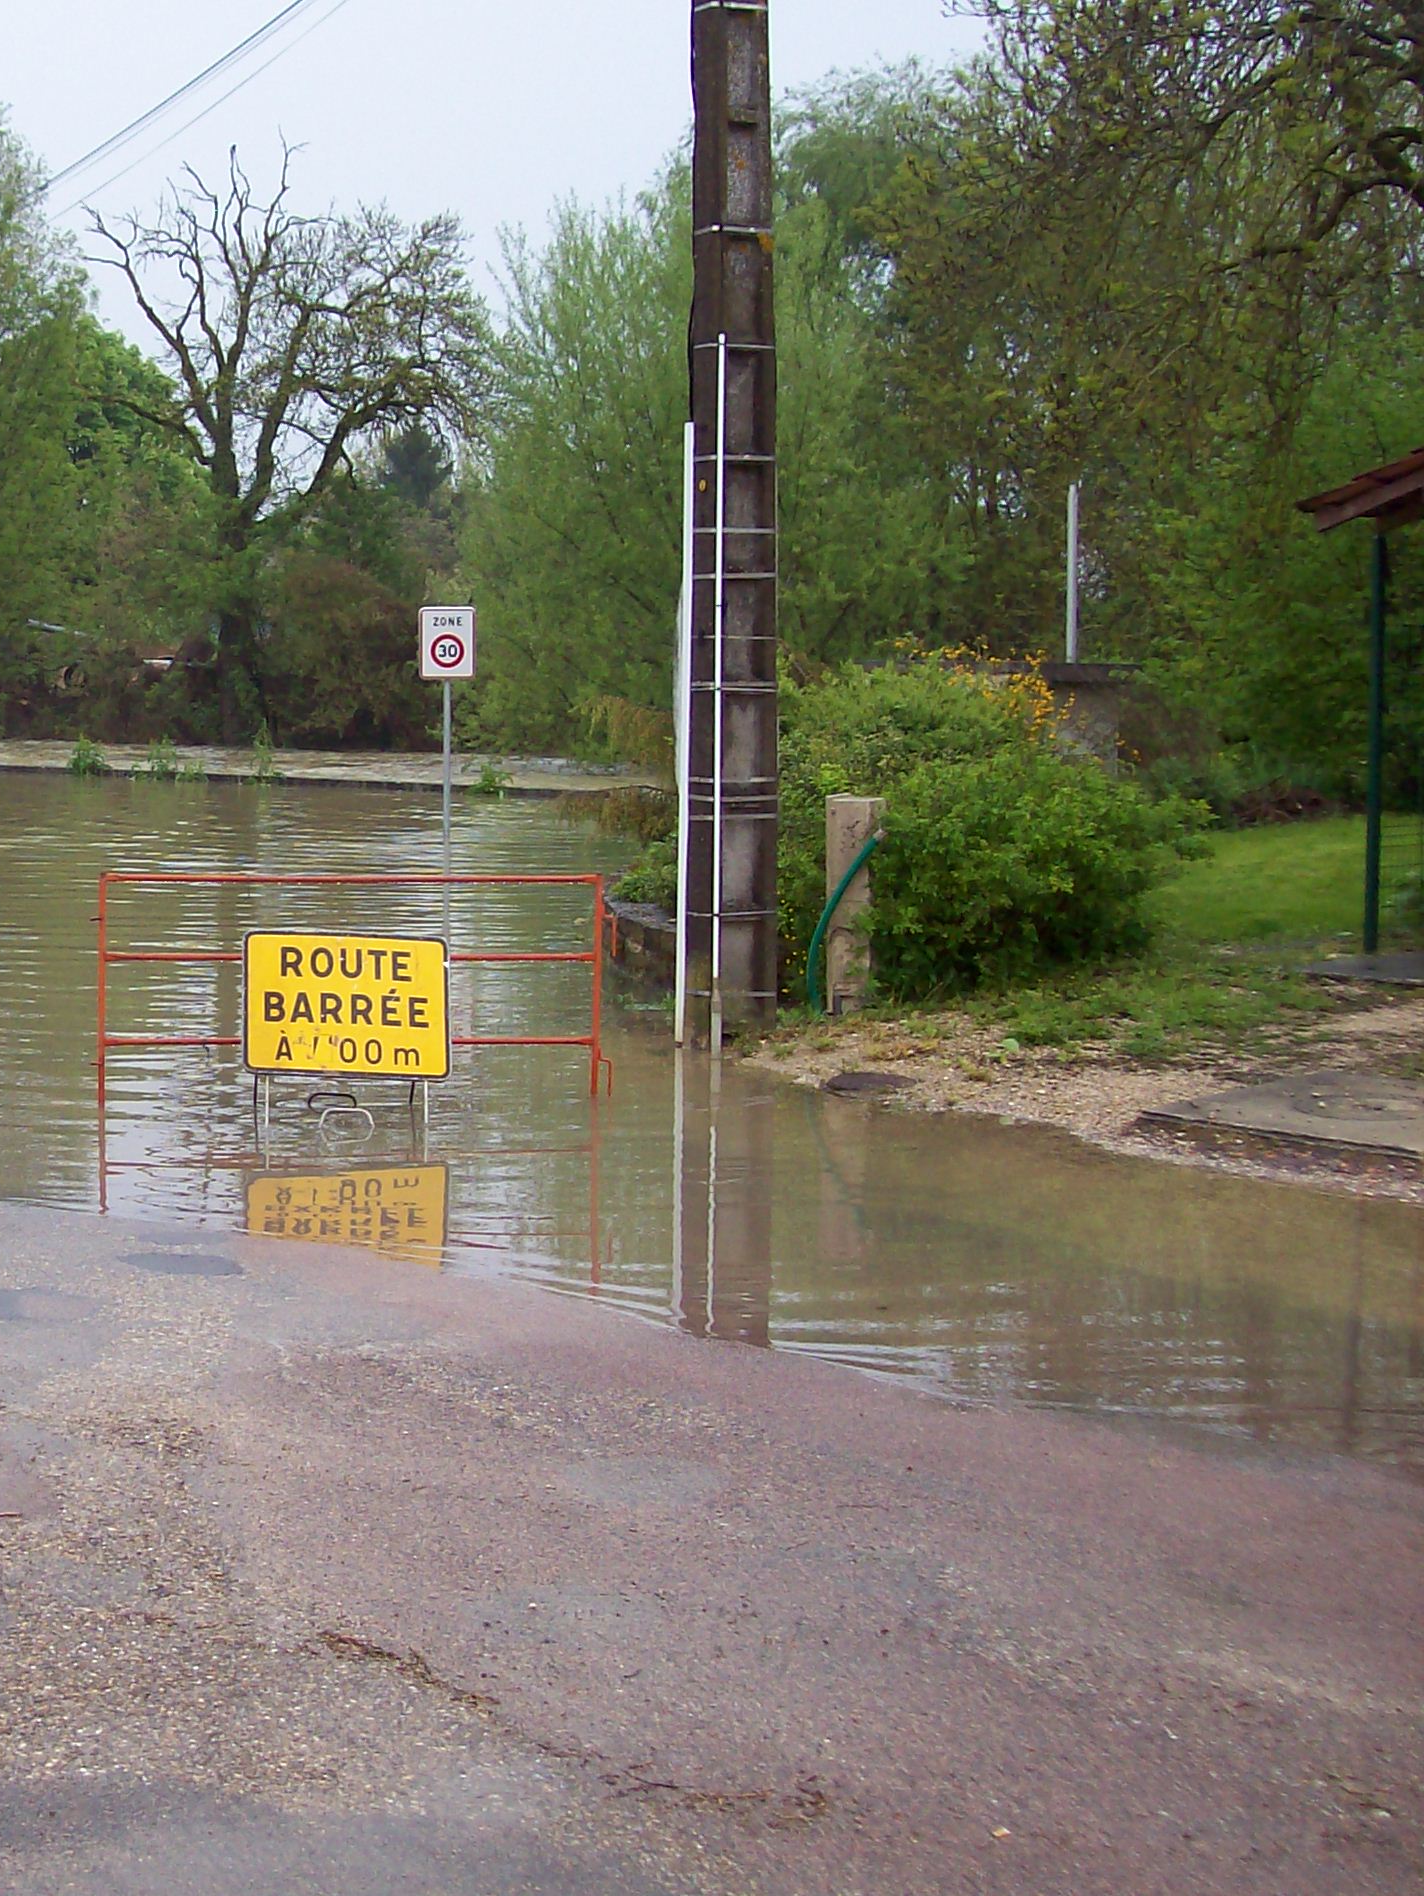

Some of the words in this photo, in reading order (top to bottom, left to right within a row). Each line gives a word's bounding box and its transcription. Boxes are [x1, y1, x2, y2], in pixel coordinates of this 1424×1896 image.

[433, 616, 463, 627] ZONE
[438, 644, 458, 658] 30
[280, 946, 412, 982] ROUTE
[263, 988, 430, 1029] BARRÉE
[275, 1030, 293, 1061] À
[393, 1046, 420, 1066] m
